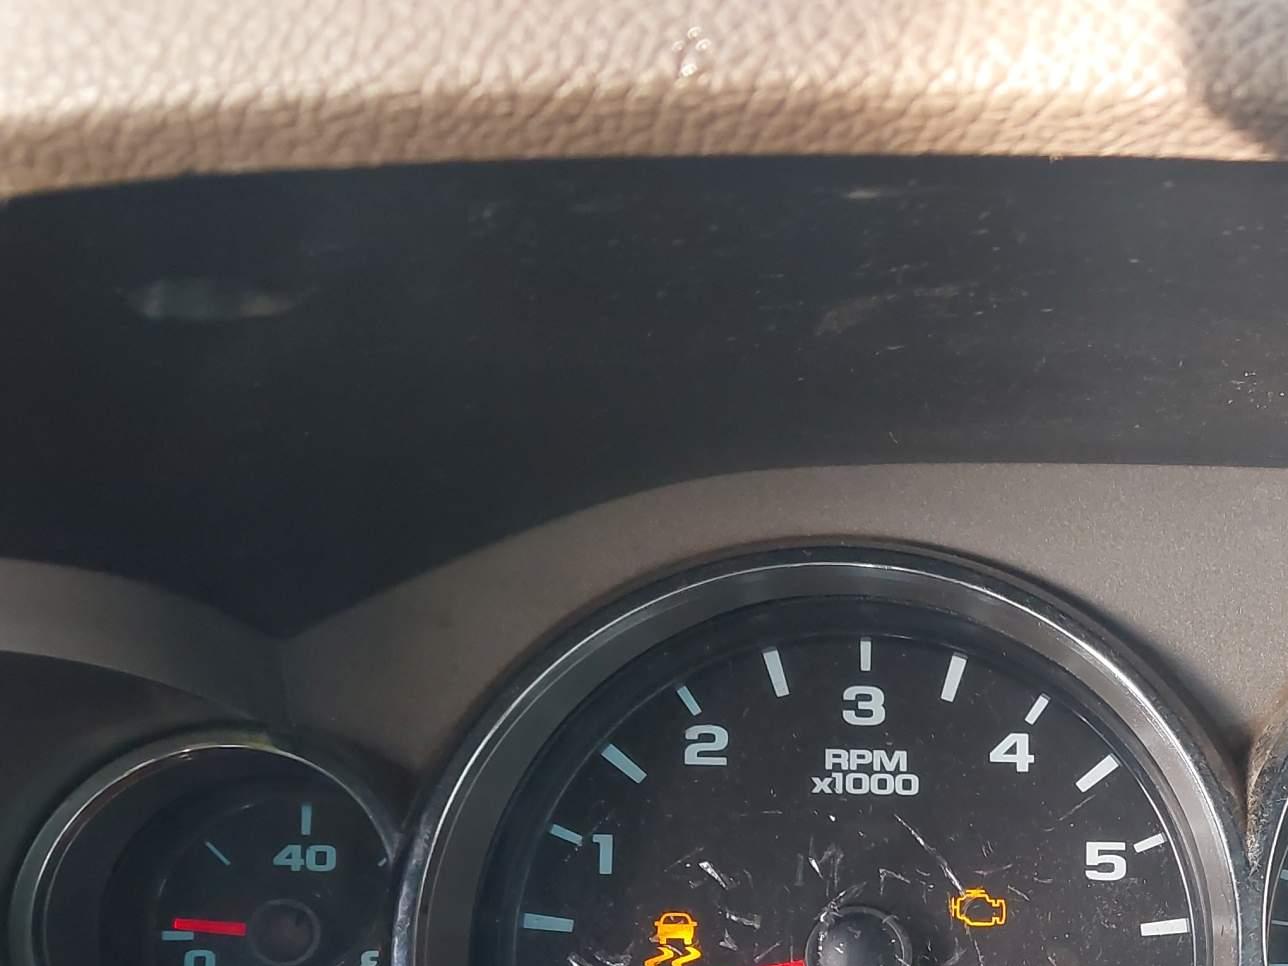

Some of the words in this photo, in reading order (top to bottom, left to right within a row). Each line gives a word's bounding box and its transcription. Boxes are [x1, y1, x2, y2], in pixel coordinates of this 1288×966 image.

[842, 687, 886, 726] 3
[684, 727, 728, 766] 2
[825, 750, 908, 772] RPM
[989, 733, 1035, 772] 4
[812, 773, 919, 796] x1000
[273, 844, 337, 872] 40
[593, 834, 613, 874] 1
[1084, 841, 1127, 880] 5
